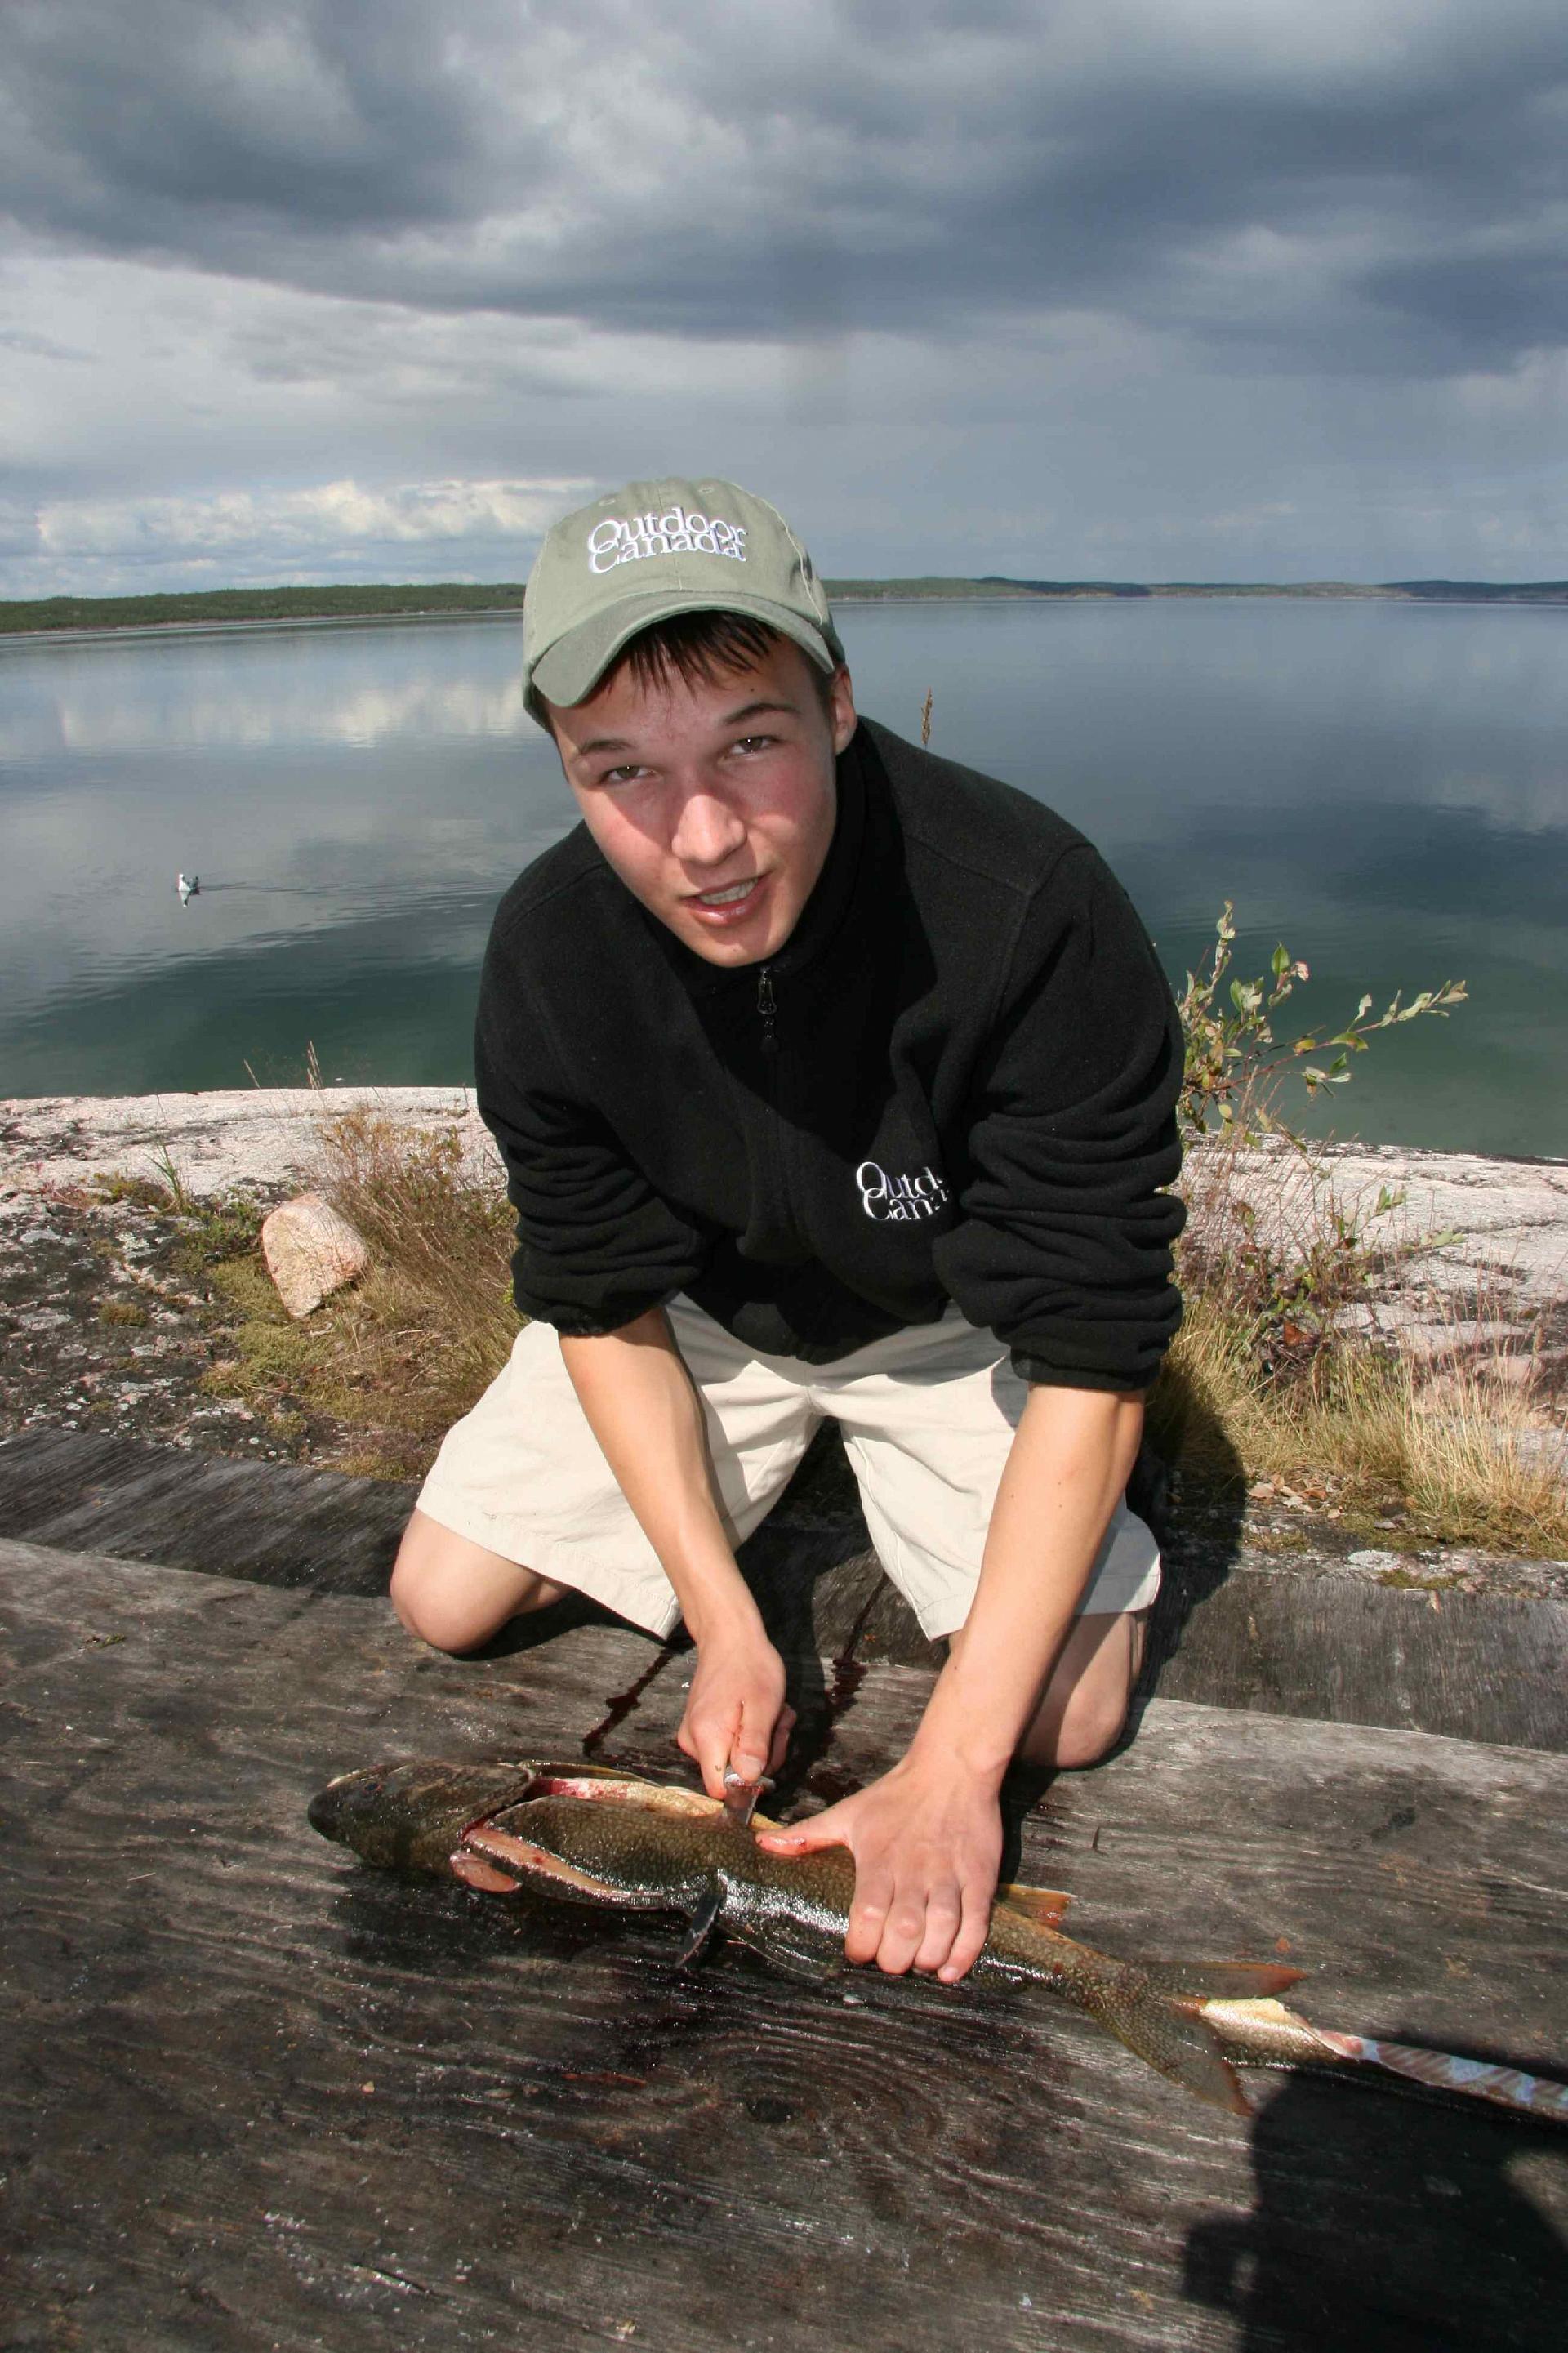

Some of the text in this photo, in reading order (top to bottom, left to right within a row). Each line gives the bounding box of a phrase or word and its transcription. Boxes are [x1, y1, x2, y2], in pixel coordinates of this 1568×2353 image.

[588, 506, 746, 553] Outdoor
[590, 531, 746, 573] Canada
[856, 1161, 943, 1198] Outd
[863, 1188, 947, 1220] Can
